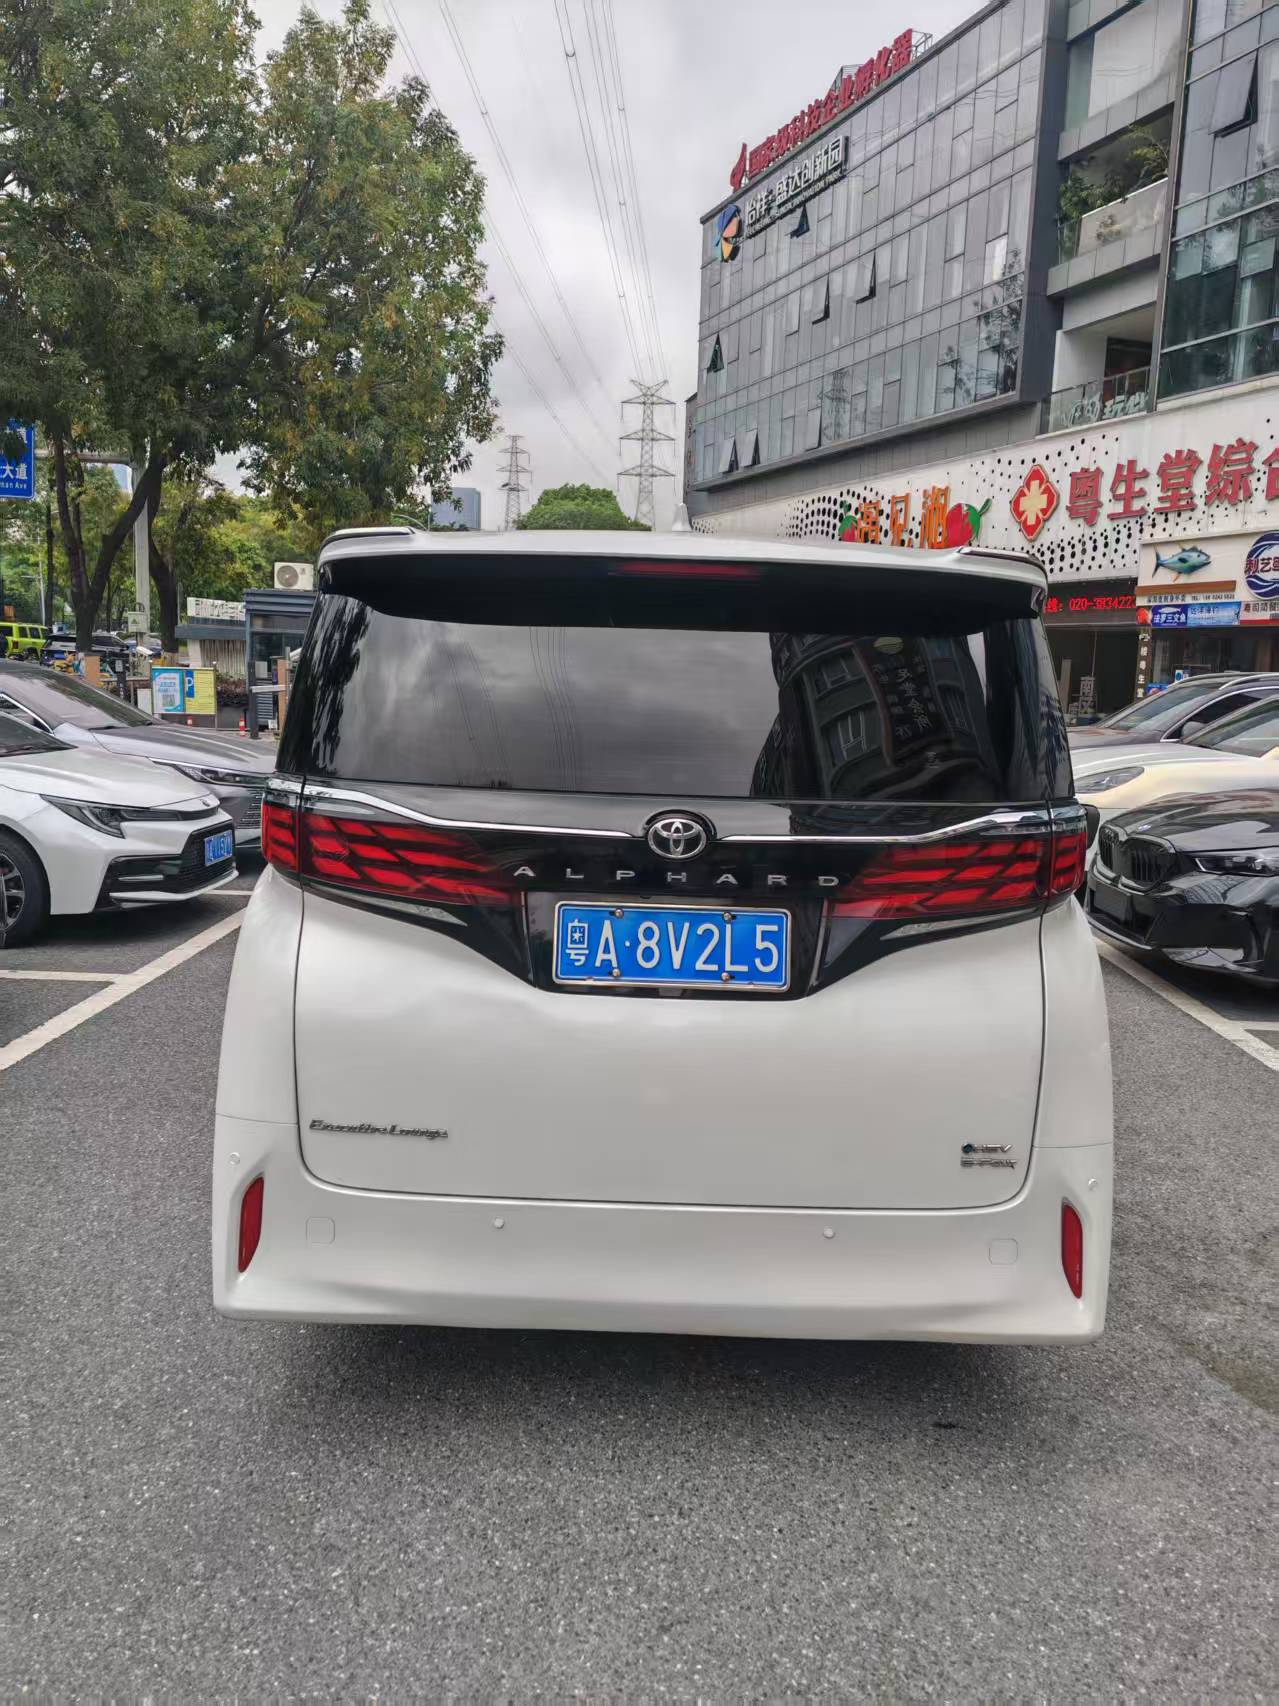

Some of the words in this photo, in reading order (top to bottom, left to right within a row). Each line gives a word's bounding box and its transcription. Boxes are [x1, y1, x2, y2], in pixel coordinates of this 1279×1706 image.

[749, 28, 912, 179] 国家级科技企业孵化器
[0, 463, 27, 480] 大道
[513, 865, 839, 886] ALPHARD
[565, 919, 779, 973] 粤A·8V2L5
